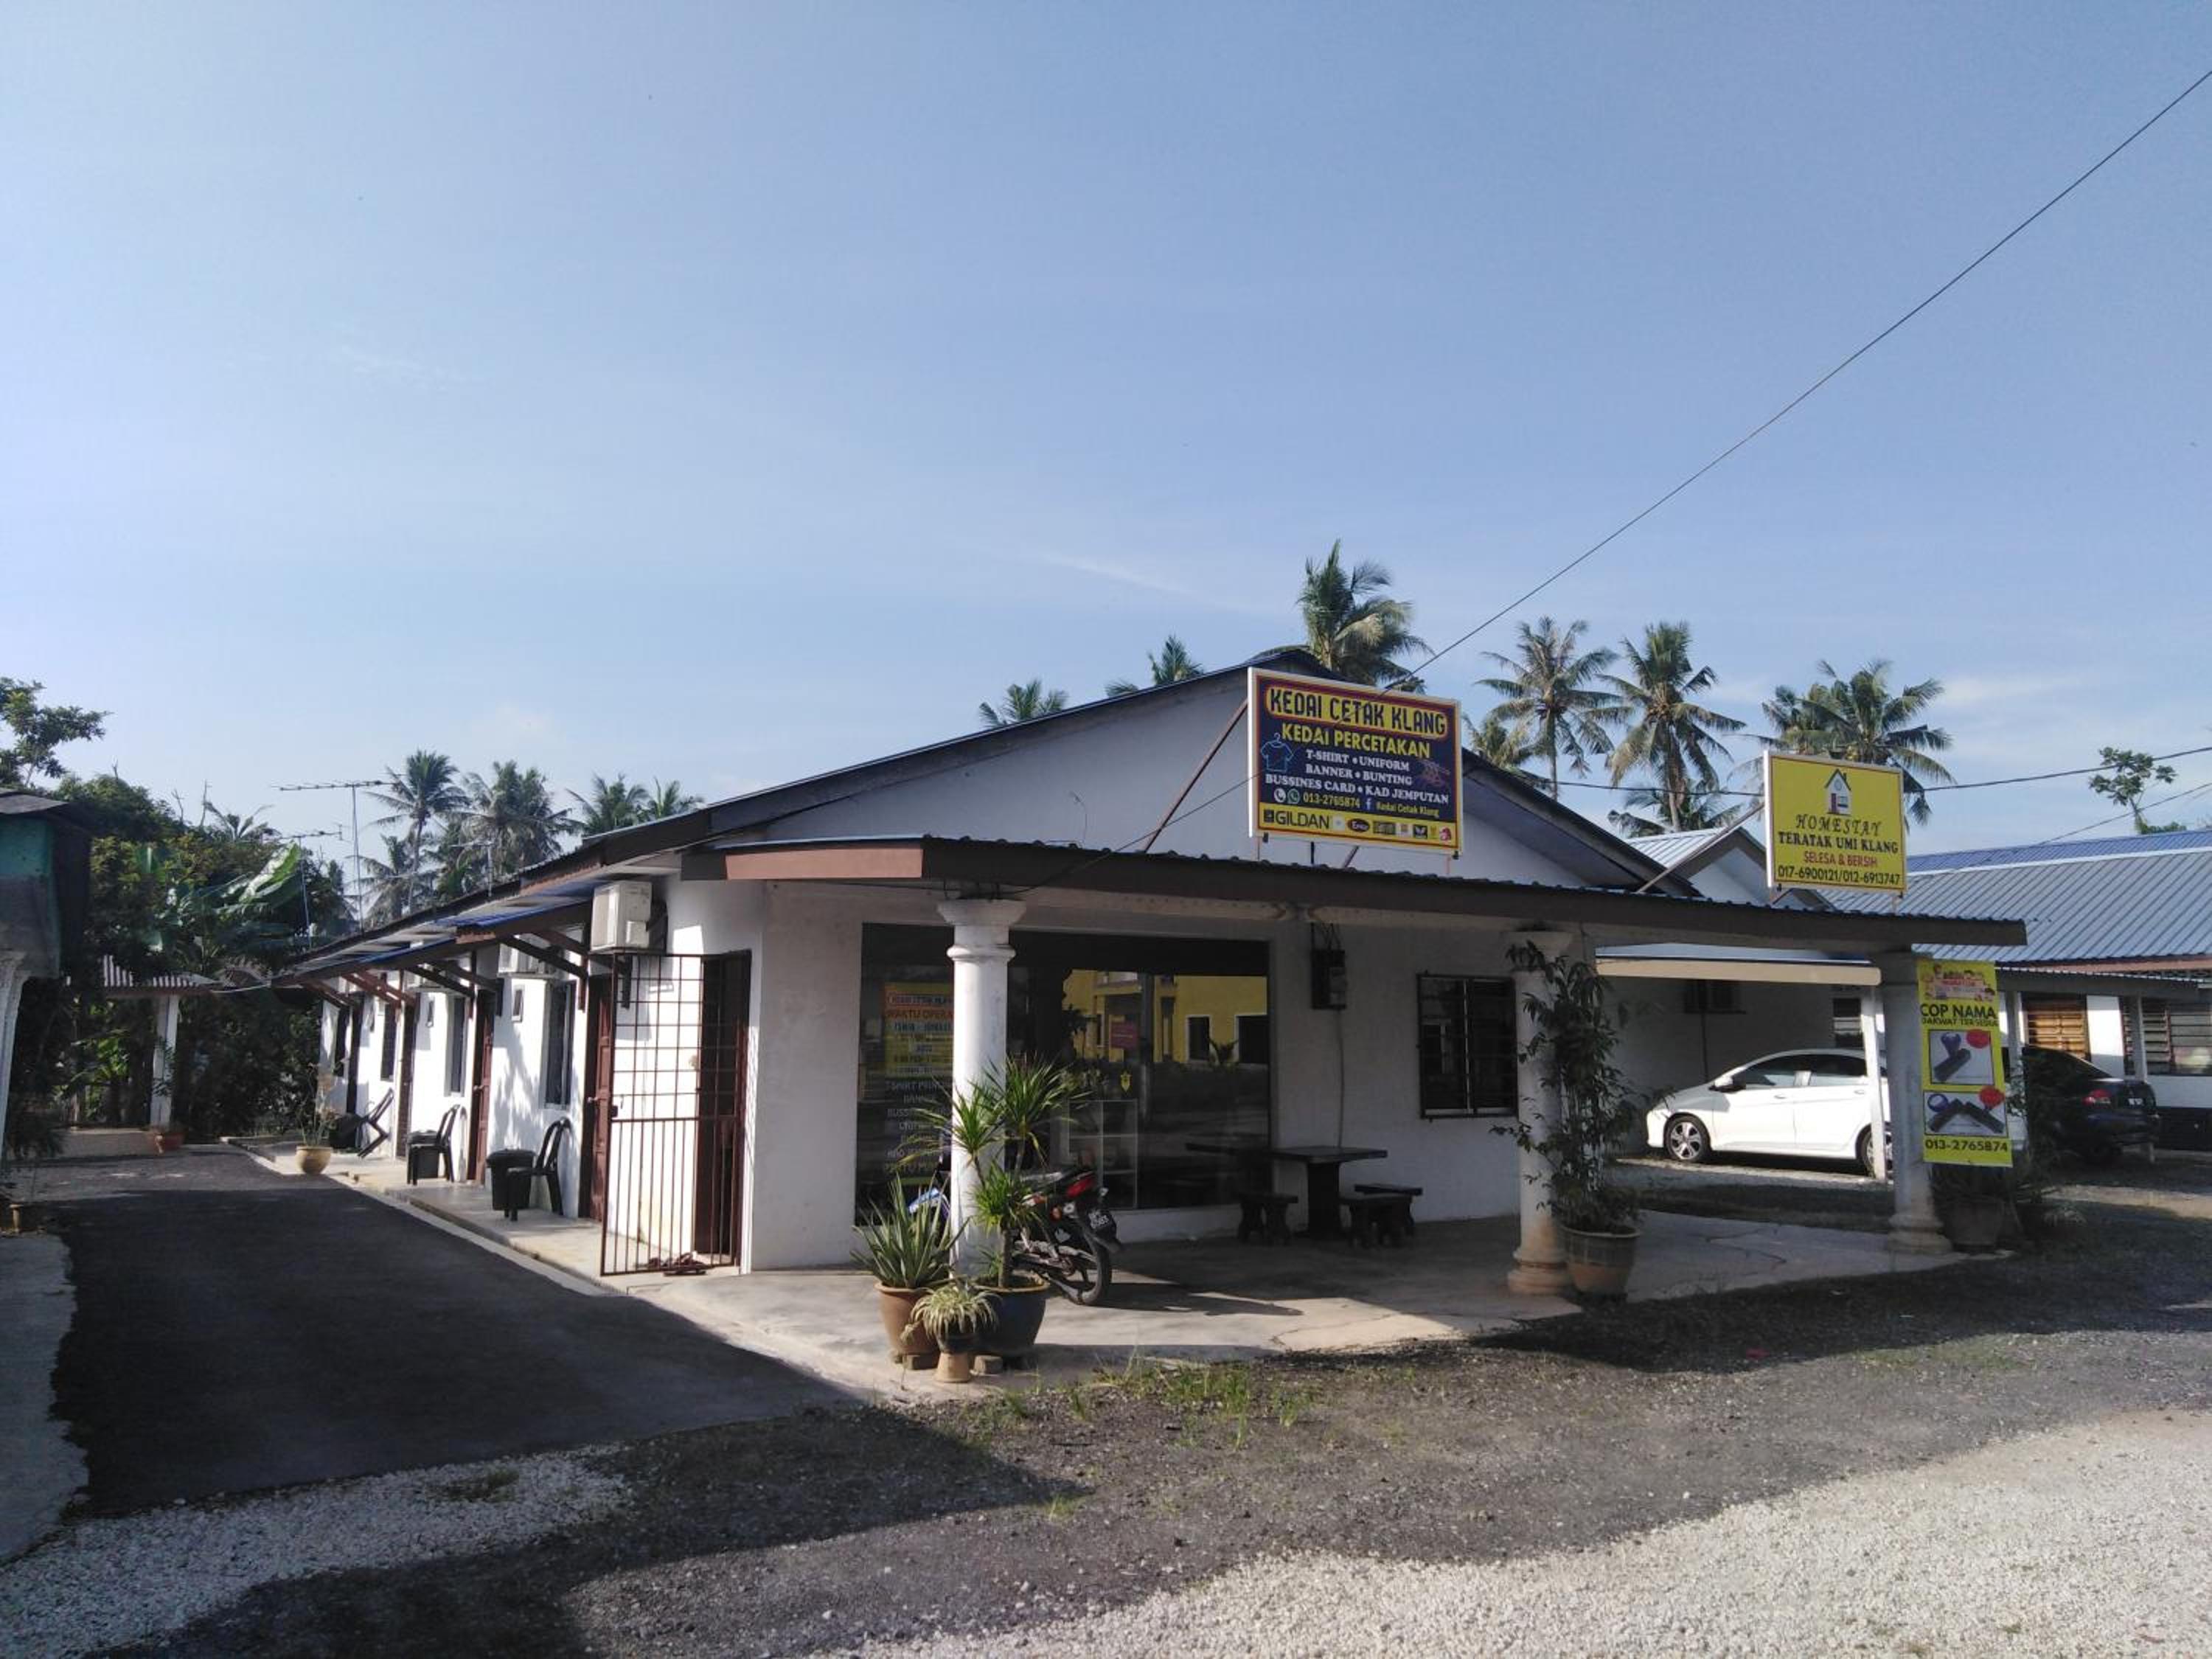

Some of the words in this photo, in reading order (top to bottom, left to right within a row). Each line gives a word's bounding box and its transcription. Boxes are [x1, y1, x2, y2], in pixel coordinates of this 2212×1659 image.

[1270, 689, 1322, 719] KEDAI
[1329, 698, 1385, 728] CETAK
[1392, 707, 1446, 736] KLANG
[1281, 723, 1329, 745] KEDAI
[1334, 729, 1430, 758] PERCETAKAN
[1306, 749, 1349, 764] T-SHIRT
[1359, 757, 1410, 771] UNIFORM
[1306, 764, 1353, 779] BANNER
[1363, 771, 1412, 785] BUNTING
[1265, 774, 1321, 790] BUSSINES
[1324, 779, 1355, 793] CARD
[1365, 785, 1390, 797] KAD
[1392, 788, 1449, 804] JEMPUTAN
[1276, 811, 1329, 830] GILDAN
[1796, 814, 1882, 837] HOMESTAY
[1778, 832, 1832, 849] TERATAK
[1836, 837, 1857, 850] UMI
[1860, 839, 1899, 854] KLANG
[1804, 851, 1836, 865] SELESA
[1848, 855, 1877, 868] BERSIH
[1920, 1004, 1948, 1017] COP
[1952, 1004, 1997, 1019] NAMA
[1925, 1139, 2008, 1152] 013-2765874
